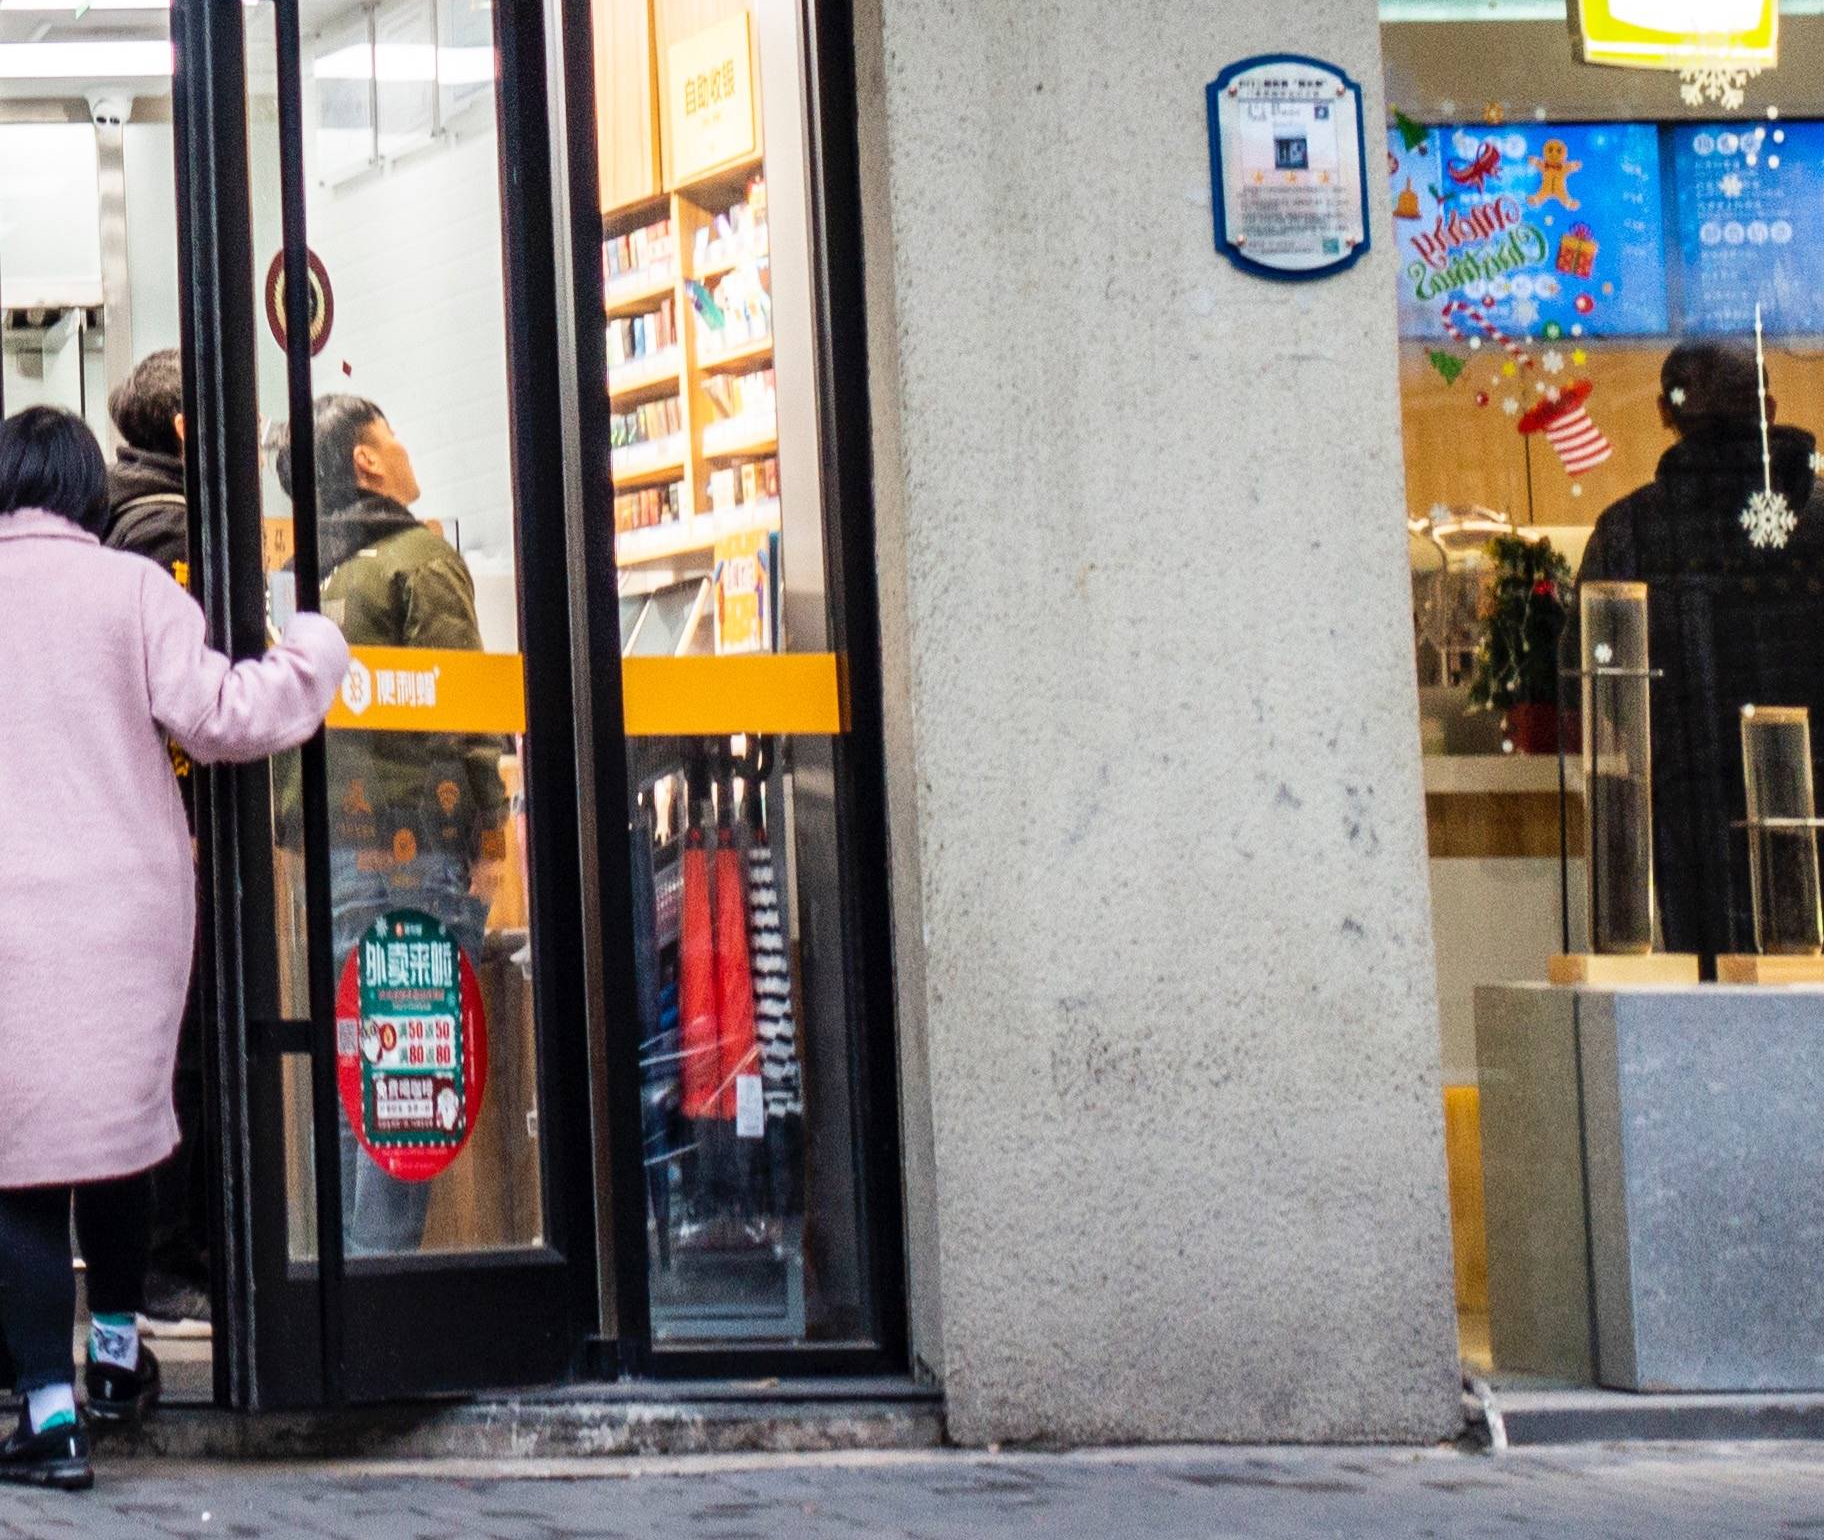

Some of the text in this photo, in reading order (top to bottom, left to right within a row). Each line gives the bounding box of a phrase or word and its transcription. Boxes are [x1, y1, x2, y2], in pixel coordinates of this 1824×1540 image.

[376, 668, 437, 708] 便利蜂
[366, 941, 453, 987] 外卖来啦
